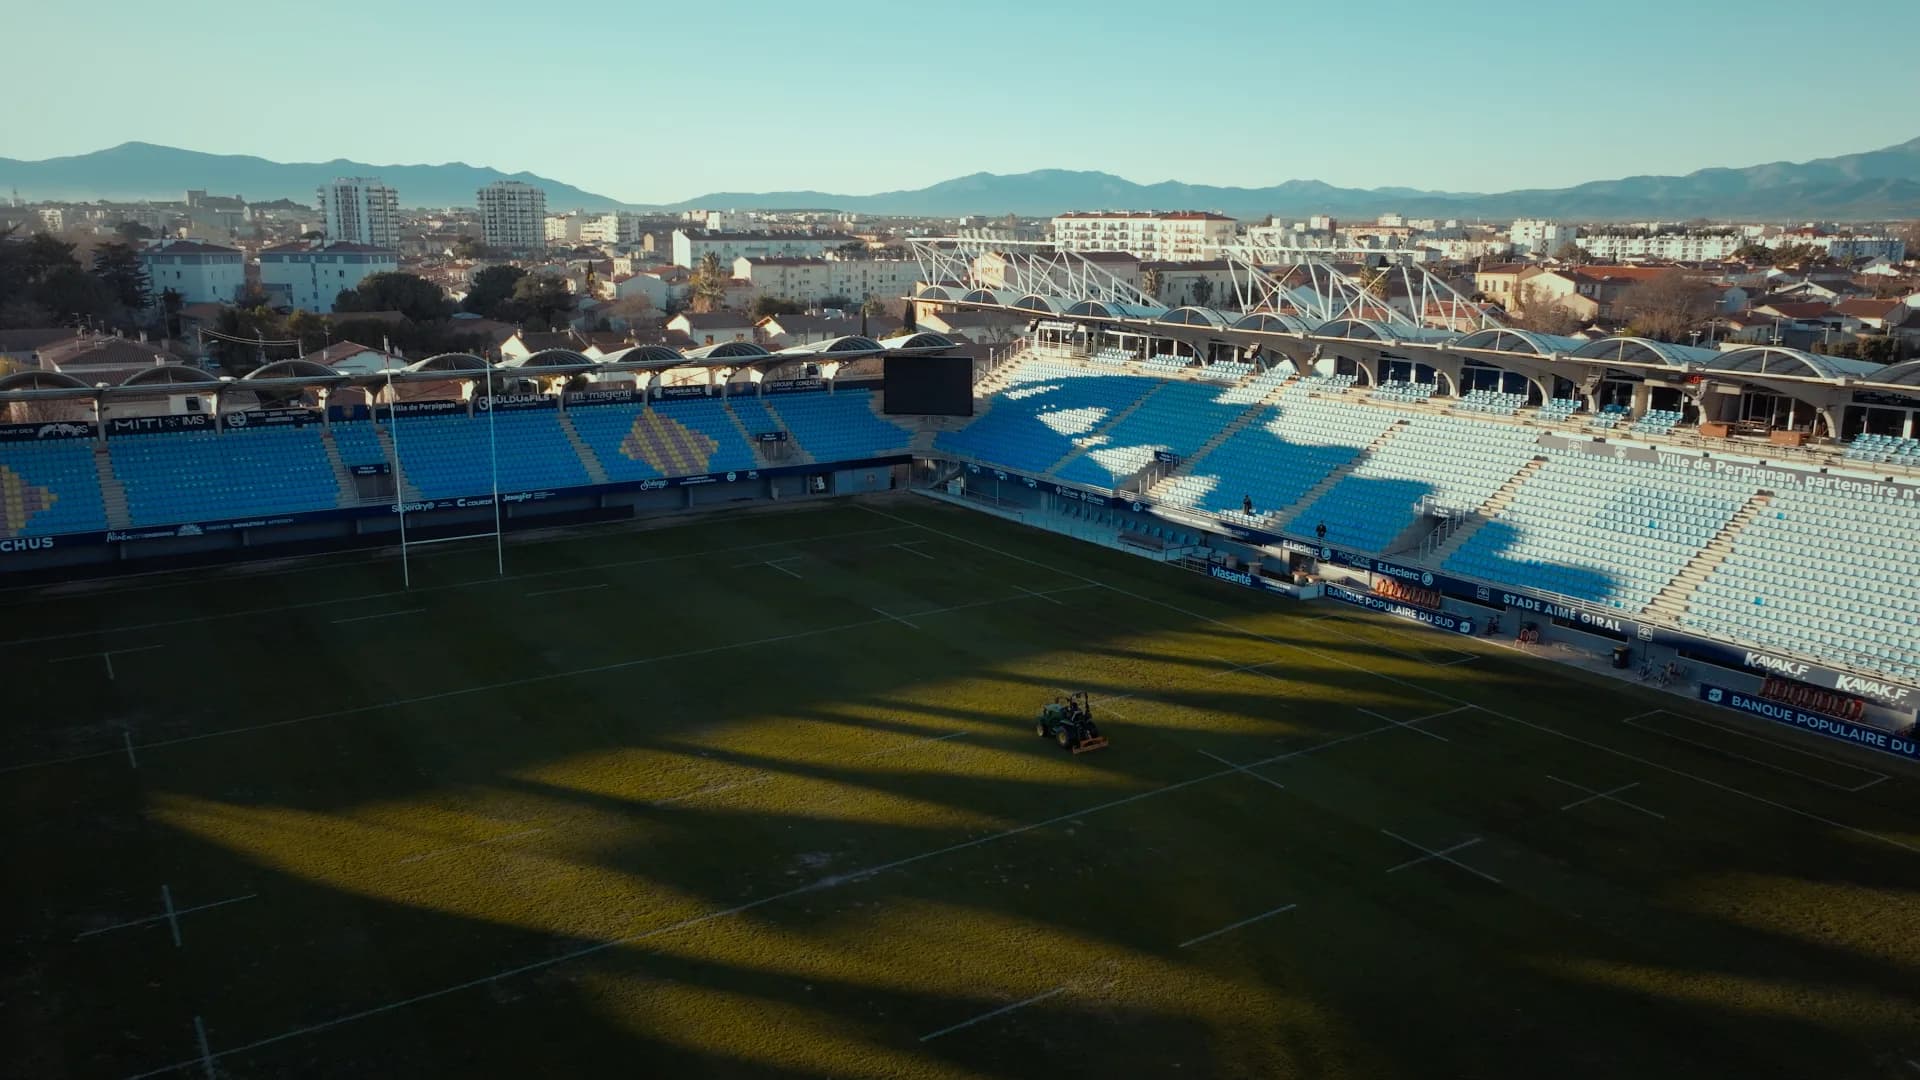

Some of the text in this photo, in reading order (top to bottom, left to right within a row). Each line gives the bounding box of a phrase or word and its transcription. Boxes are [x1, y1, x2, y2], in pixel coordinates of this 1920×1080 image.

[1657, 452, 1690, 467] Ville
[1693, 458, 1712, 470] de
[1804, 475, 1898, 498] partenaire
[1283, 539, 1319, 556] E.Leclerc
[1377, 562, 1420, 581] E.Leclerc
[1327, 587, 1455, 628] BANQUE POPULAIRE DU SUD
[1503, 594, 1622, 632] STADE AIMÉ GIRAL
[1731, 696, 1916, 755] BANQUE POPULAIRE DU
